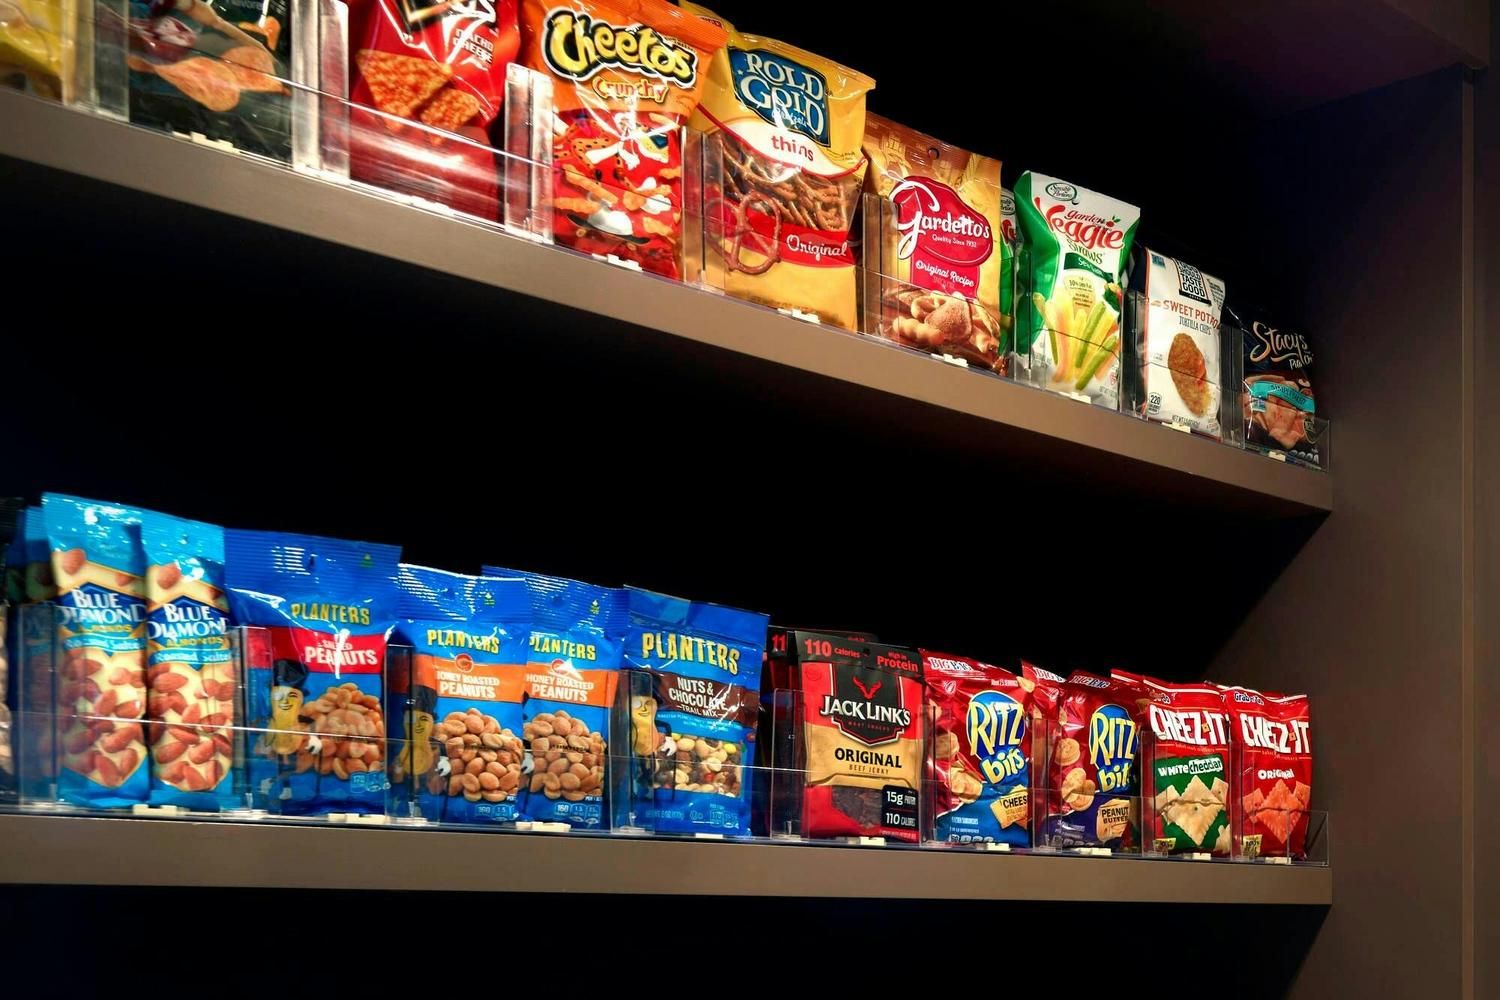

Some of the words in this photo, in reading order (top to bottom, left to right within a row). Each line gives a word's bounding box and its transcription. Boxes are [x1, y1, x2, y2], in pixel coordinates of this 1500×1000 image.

[551, 14, 692, 79] Cheetos
[745, 53, 824, 101] ROLD
[593, 77, 669, 102] Crunchy
[740, 75, 825, 136] GOLD
[771, 135, 814, 161] thins
[889, 181, 991, 260] Gardetto's
[787, 234, 849, 261] Original
[915, 260, 950, 279] Original
[949, 271, 975, 288] Recipe
[1181, 274, 1203, 289] TASTE
[1182, 283, 1206, 298] GOOD
[1163, 300, 1194, 318] SWEET
[1250, 321, 1308, 362] Stacy's
[71, 588, 122, 609] BLUE
[163, 604, 214, 623] BLUE
[291, 603, 371, 626] PLANTERS
[427, 629, 501, 655] PLANTERS
[804, 638, 832, 657] 110
[833, 647, 861, 659] calories
[641, 632, 741, 676] PLANTERS
[877, 655, 919, 673] Protein
[439, 682, 497, 700] PEANUTS
[526, 675, 555, 686] HONEY
[556, 678, 595, 691] ROASTED
[531, 684, 589, 703] PEANUTS
[677, 677, 706, 694] NUTS
[707, 682, 714, 696] &
[820, 696, 866, 721] JACK
[866, 702, 911, 726] LINK'S
[970, 701, 1025, 757] RITZ
[1090, 712, 1135, 767] RITZ
[835, 747, 902, 769] ORIGINAL
[848, 763, 866, 771] BEEF
[868, 765, 889, 775] JERKY
[981, 747, 1025, 786] bits
[1099, 763, 1131, 793] bit
[887, 791, 904, 806] 15g
[886, 813, 901, 825] 110
[1101, 807, 1129, 818] PEANUT
